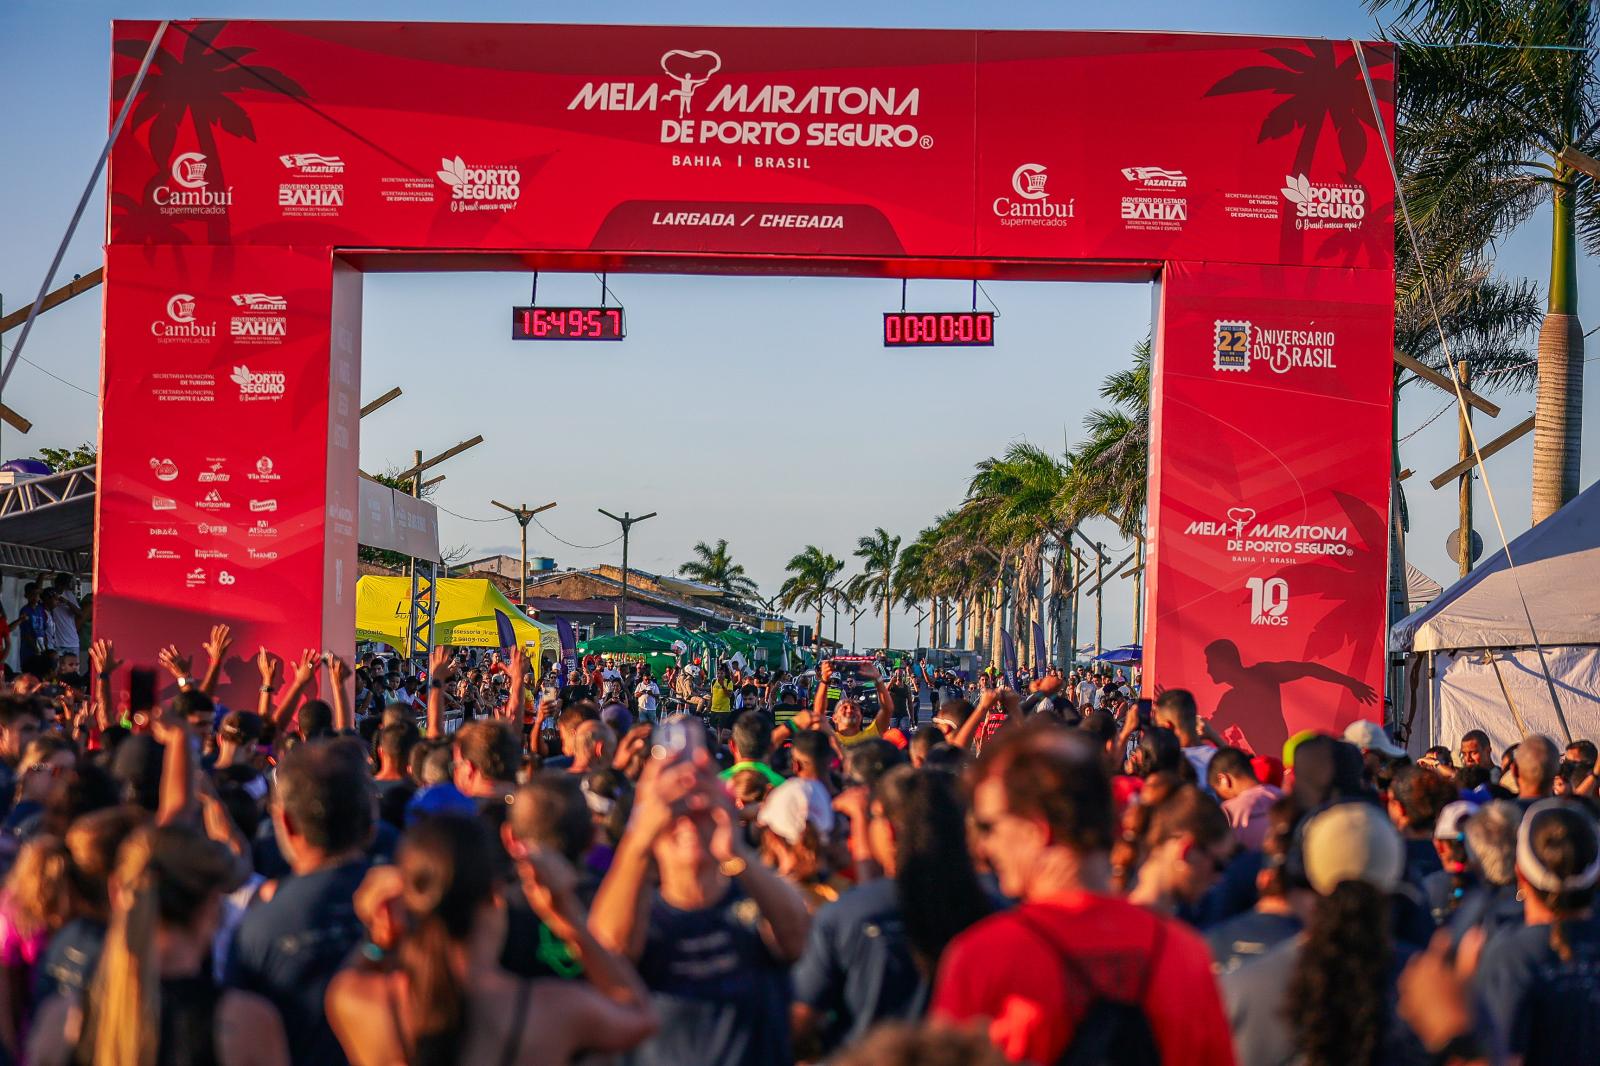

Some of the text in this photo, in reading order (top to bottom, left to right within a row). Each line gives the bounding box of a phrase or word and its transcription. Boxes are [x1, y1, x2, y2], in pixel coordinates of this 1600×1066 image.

[567, 82, 919, 116] MEIA MARATONA
[660, 120, 693, 144] DE
[700, 120, 799, 146] PORTO
[672, 155, 722, 167] BAHIA
[754, 157, 810, 169] BRASIL
[463, 169, 520, 185] PORTO
[153, 186, 234, 206] Cambuí
[279, 190, 344, 206] BAHIA
[452, 184, 520, 200] SEGURO
[1310, 188, 1365, 204] PORTO
[160, 206, 226, 216] supermercados
[993, 197, 1074, 217] Cambuí
[1121, 202, 1187, 220] BAHIA
[1297, 202, 1365, 219] SEGURO
[652, 212, 735, 226] LARGADA
[760, 214, 844, 228] CHEGADA
[1001, 218, 1067, 227] supermercados
[1304, 219, 1323, 230] Brasil
[151, 320, 216, 337] Cambuí
[231, 321, 286, 336] BAHIA
[524, 310, 620, 336] 16:49:57
[886, 315, 991, 342] 00:00:00
[1218, 331, 1247, 351] 22
[1253, 343, 1337, 373] DO BRASIL
[248, 374, 285, 384] PORTO
[240, 384, 285, 394] SEGURO
[1184, 521, 1347, 541] MEIA MARATONA
[1227, 540, 1242, 551] DE
[1245, 541, 1292, 554] PORTO
[1246, 577, 1289, 618] 10
[1253, 615, 1289, 626] ANOS
